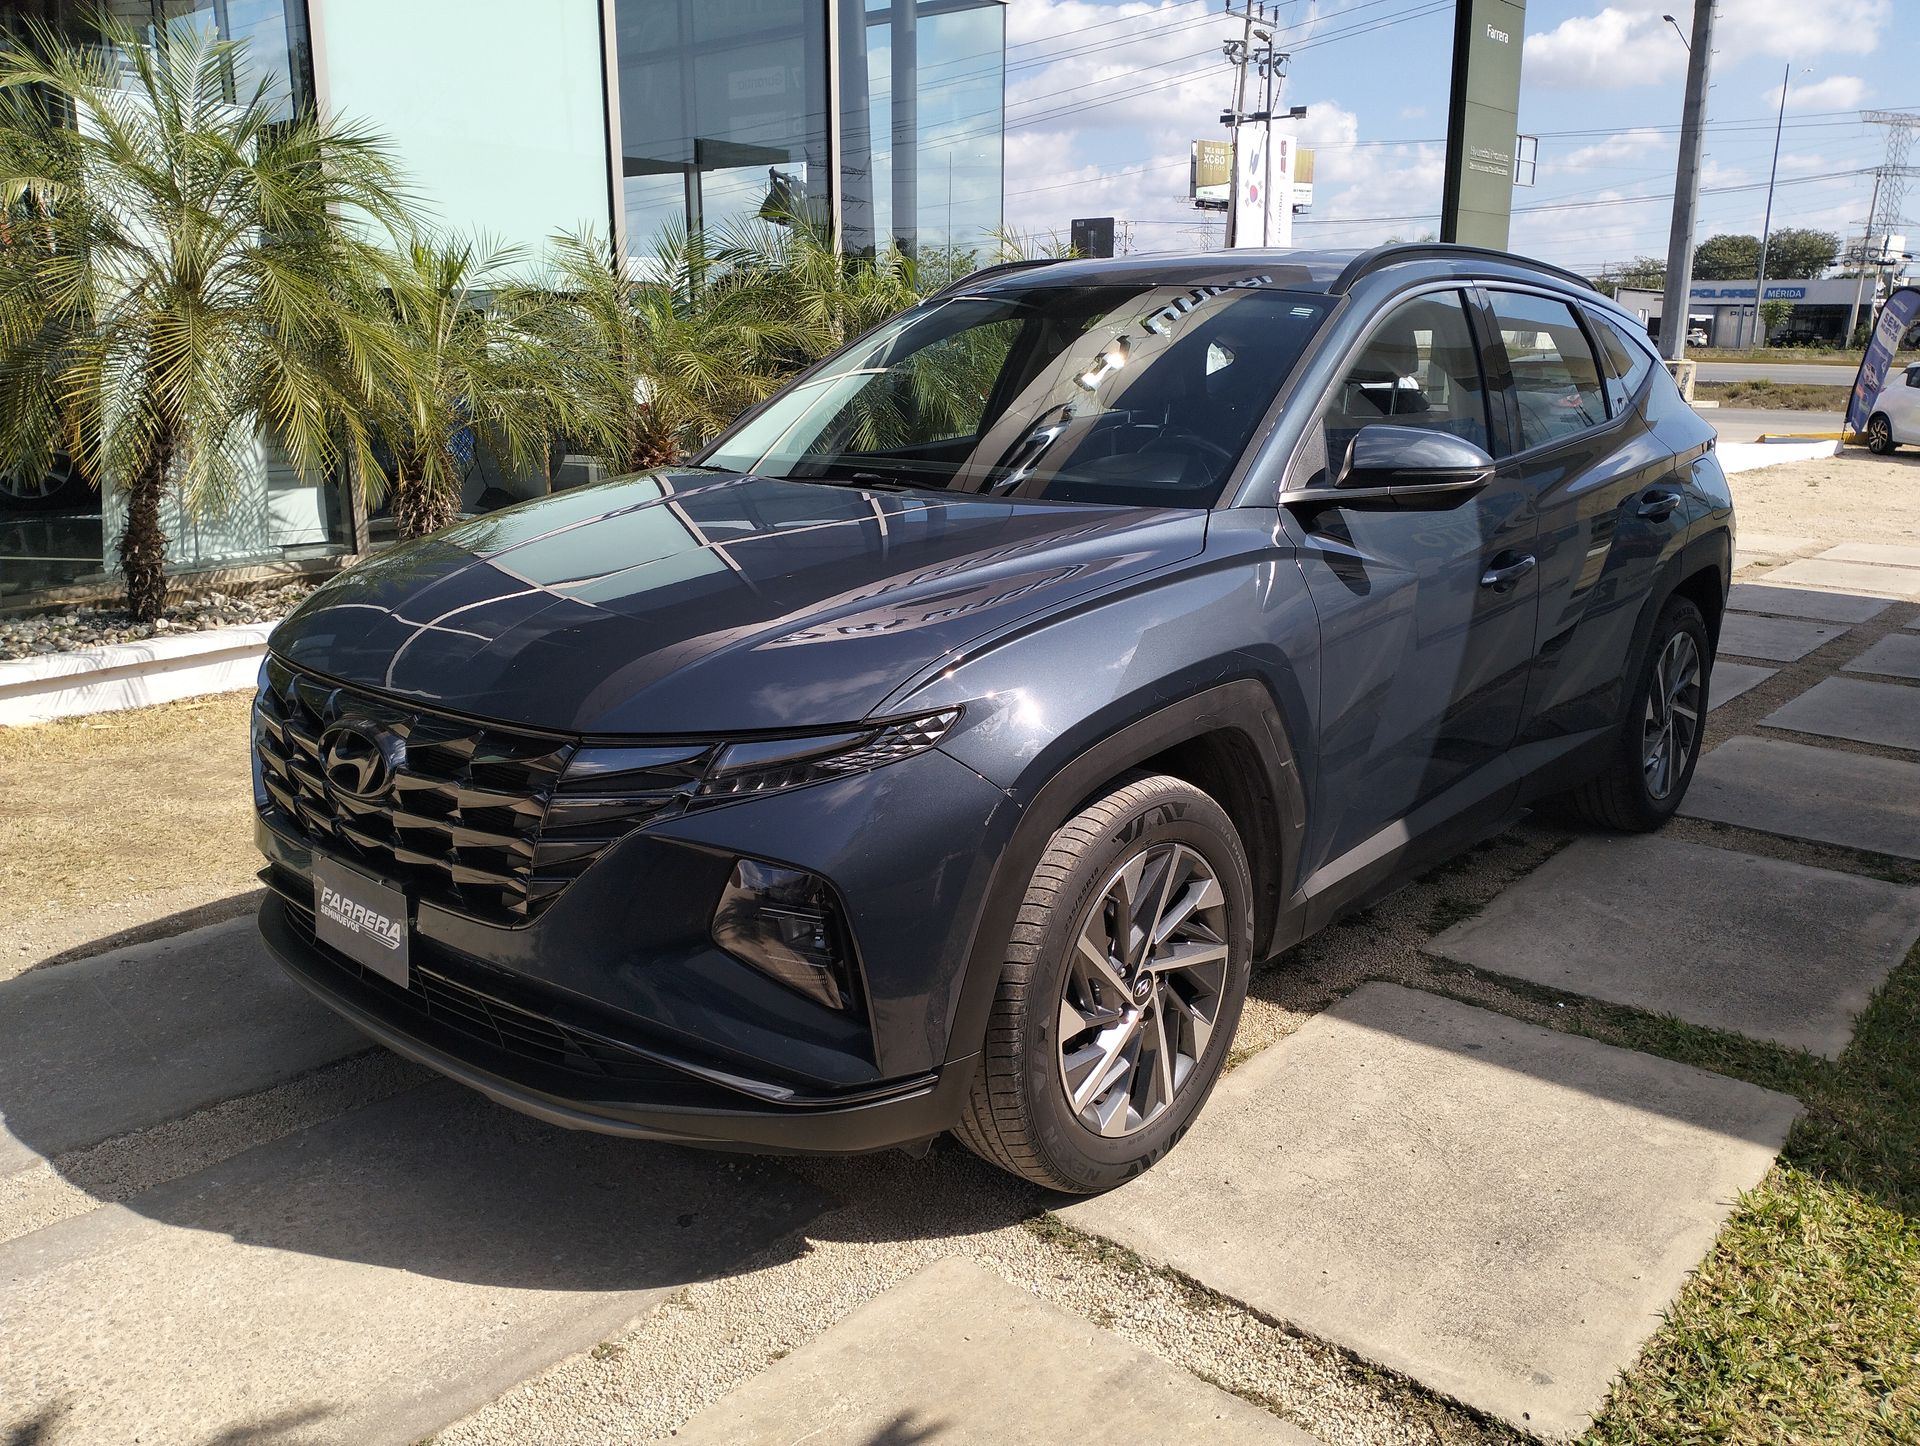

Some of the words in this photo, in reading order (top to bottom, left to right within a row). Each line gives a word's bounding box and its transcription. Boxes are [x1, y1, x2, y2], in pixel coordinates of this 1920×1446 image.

[1486, 23, 1509, 44] Farrera
[1203, 153, 1225, 165] XC60
[1767, 288, 1802, 299] MÉRIDA
[1884, 312, 1902, 334] SEMI
[320, 886, 401, 942] FARRERA
[320, 904, 360, 933] SEMINUEVOS
